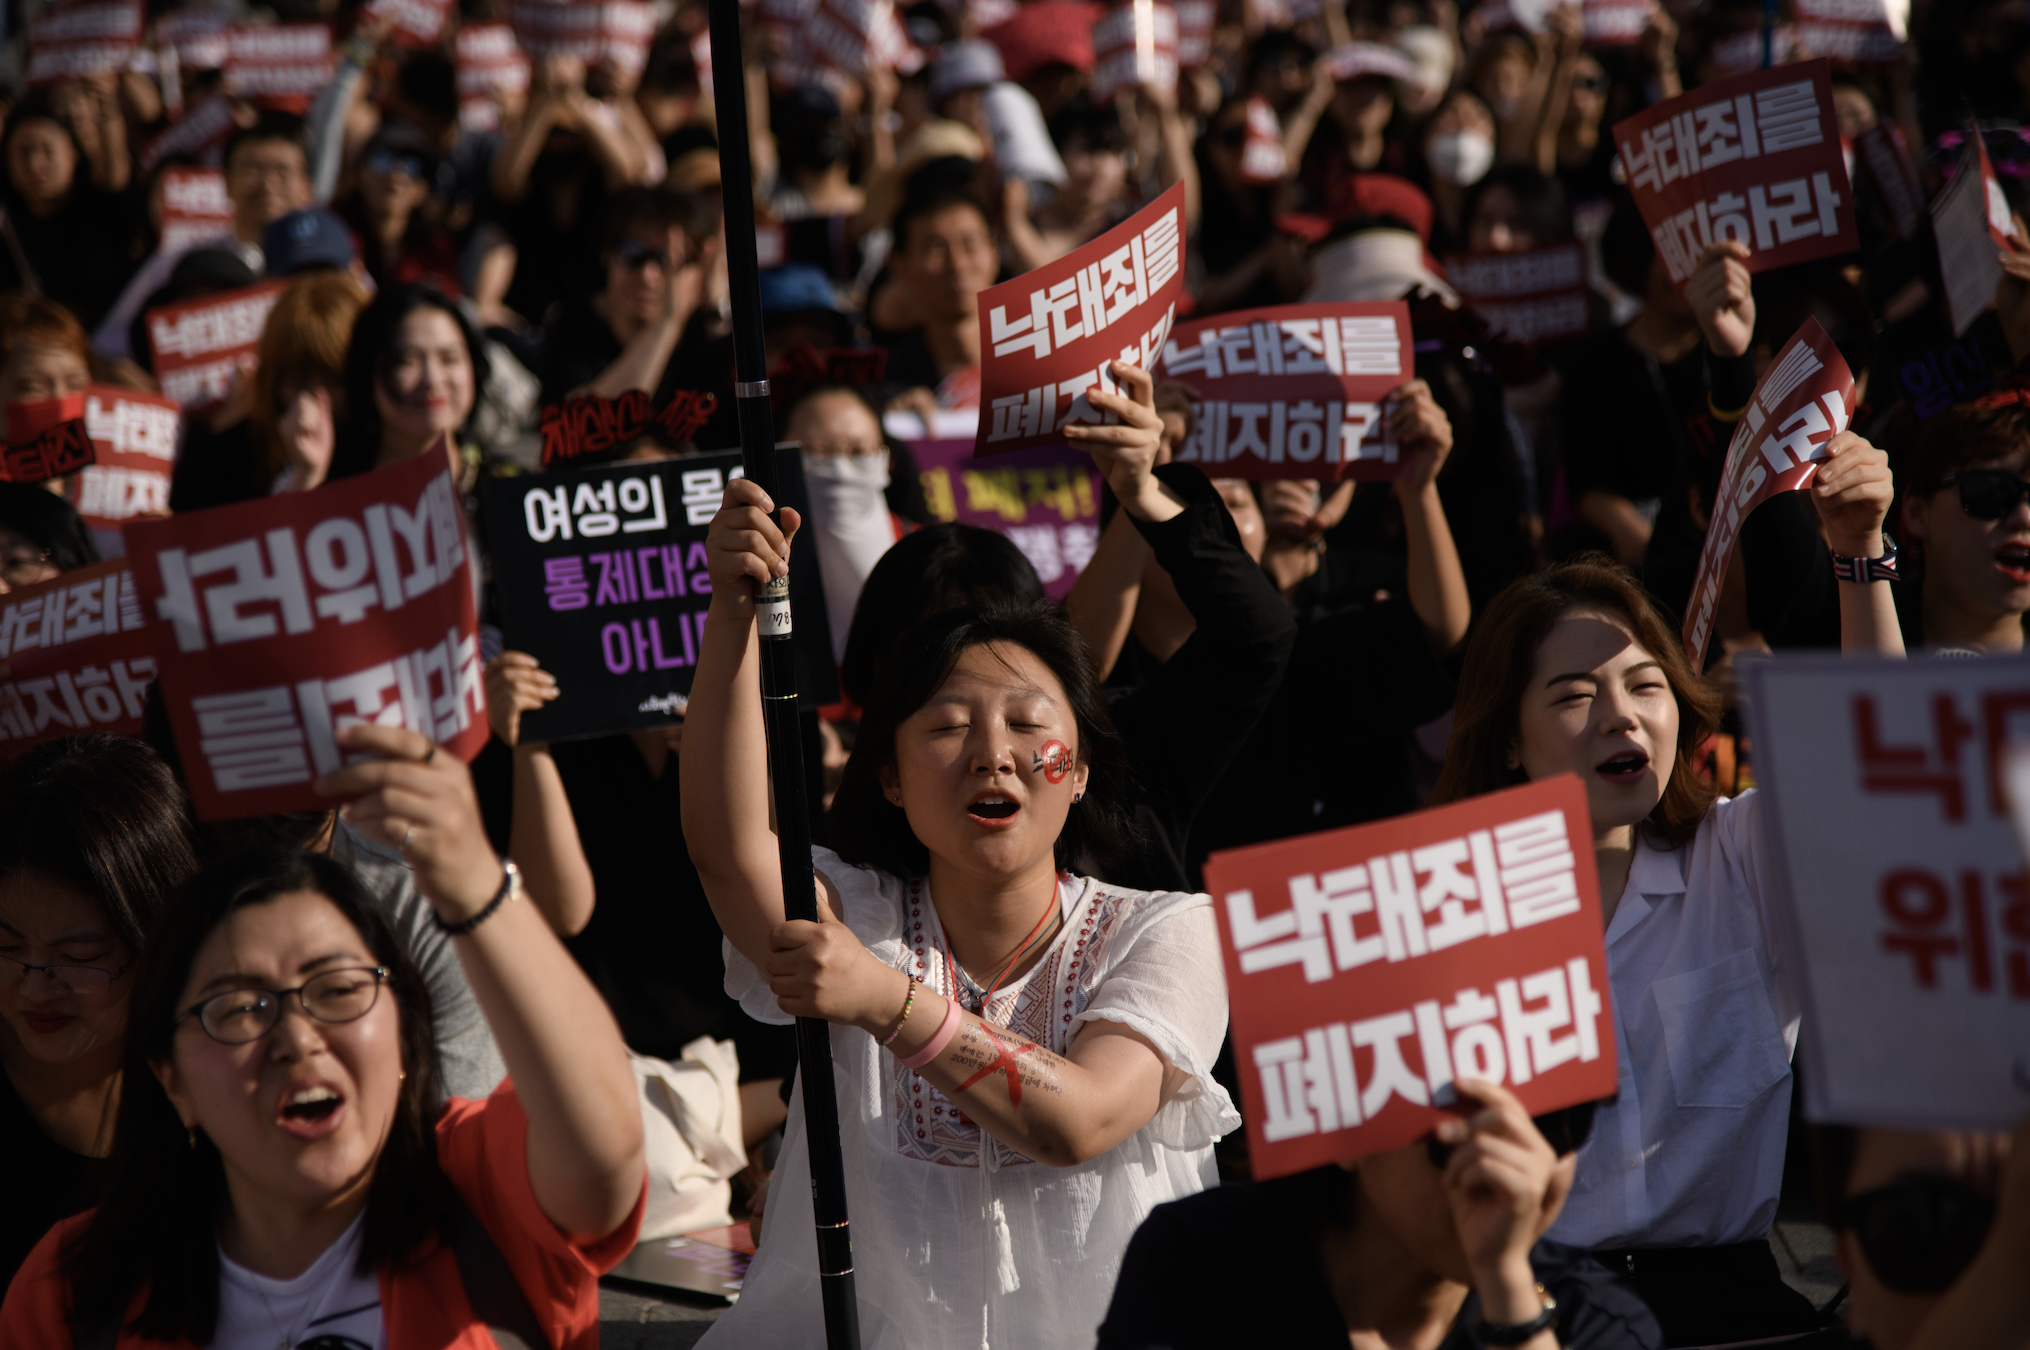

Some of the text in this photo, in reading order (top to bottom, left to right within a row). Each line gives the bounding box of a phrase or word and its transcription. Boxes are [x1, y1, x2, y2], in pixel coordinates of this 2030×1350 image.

[1621, 77, 1824, 194] 낙태죄를
[989, 206, 1179, 360] 낙태죄를
[1652, 170, 1842, 284] 폐지하라
[1162, 316, 1402, 379] 낙태죄를
[0, 419, 95, 483] 태죄
[523, 464, 746, 543] 여성의 몸
[1224, 808, 1581, 985] 낙태죄를
[1252, 955, 1602, 1143] 폐지하라
